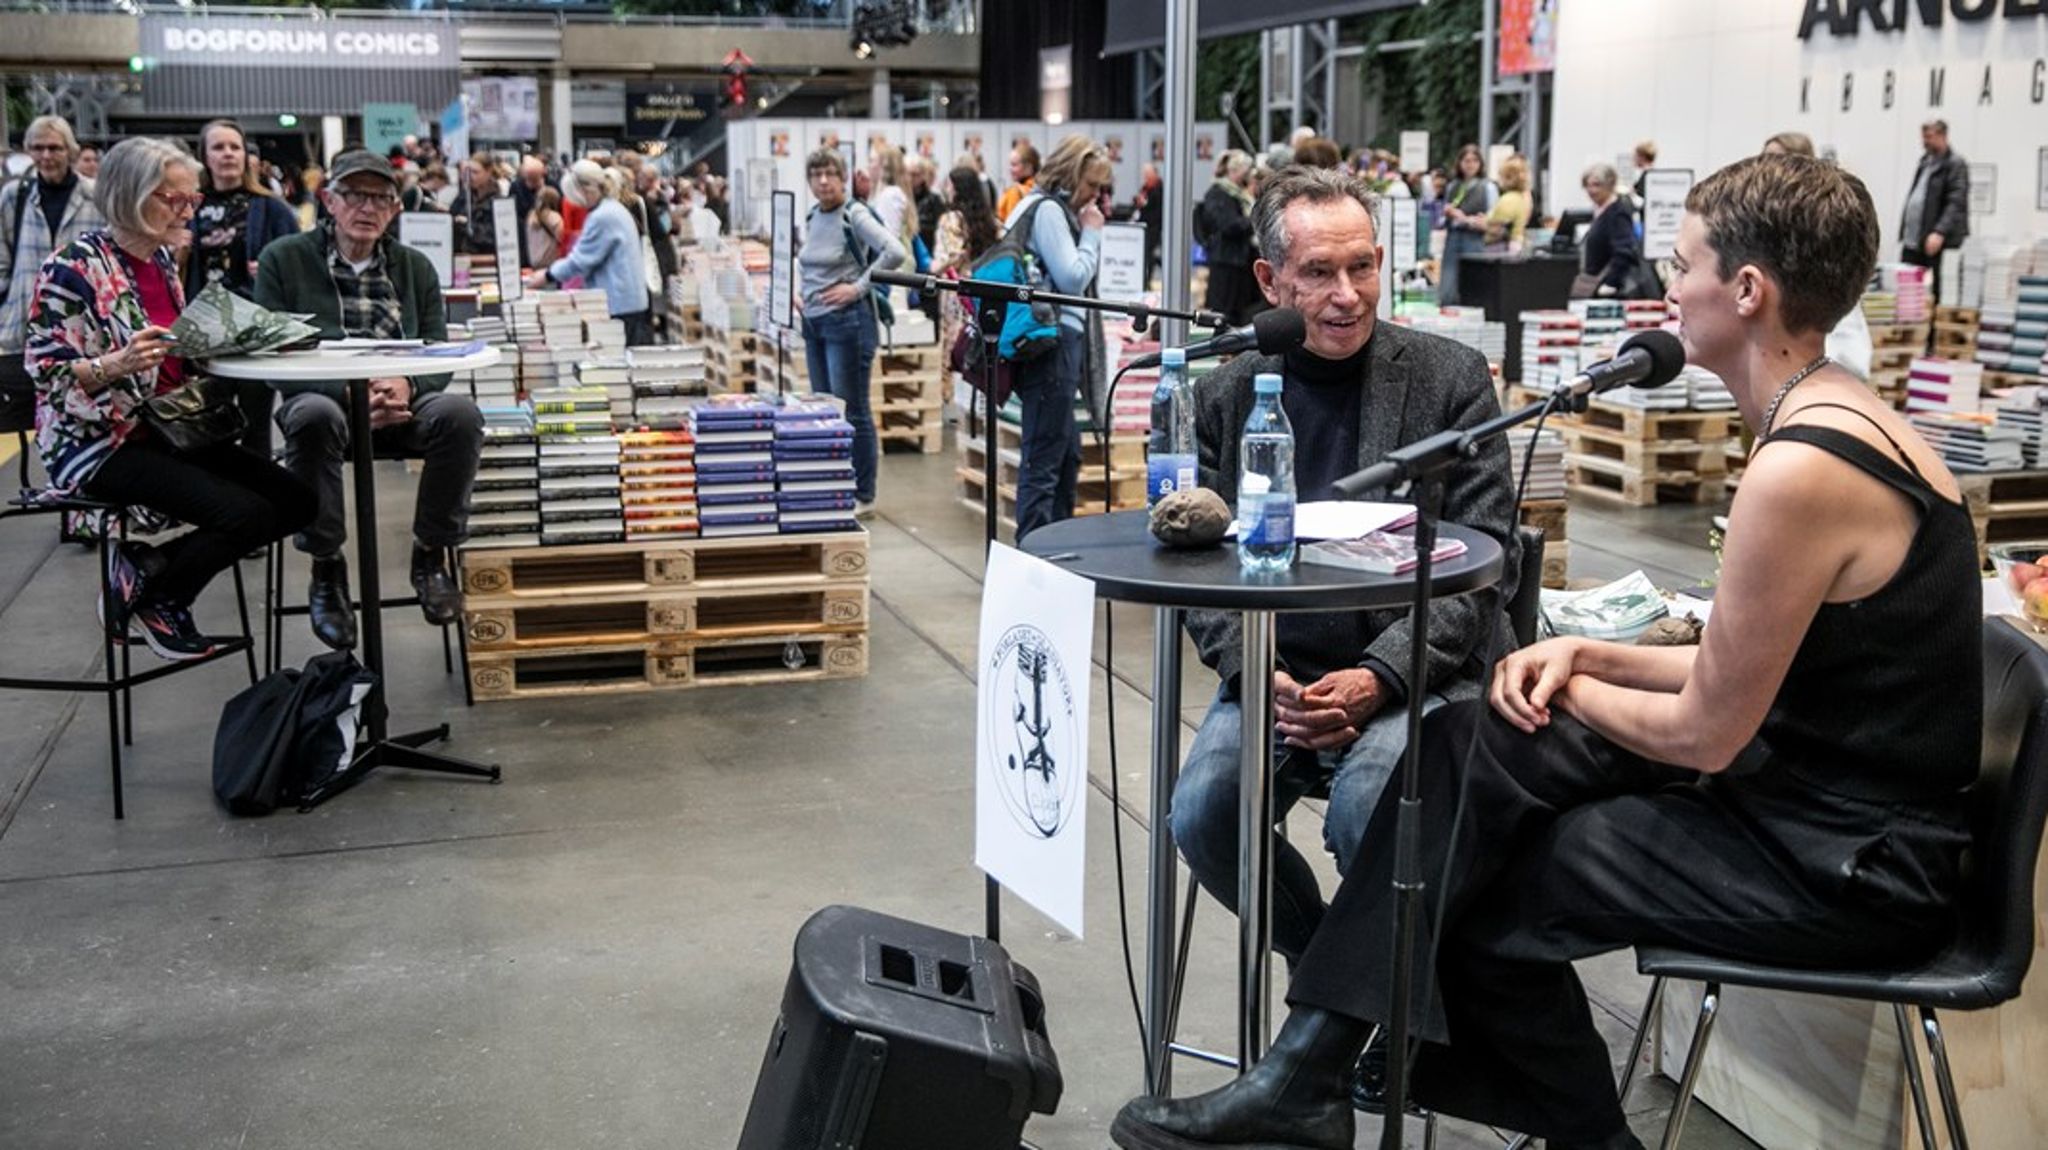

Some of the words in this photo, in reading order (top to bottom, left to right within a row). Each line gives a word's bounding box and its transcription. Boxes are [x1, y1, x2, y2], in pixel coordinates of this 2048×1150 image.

[164, 28, 327, 53] BOGFORUM
[334, 32, 440, 55] COMICS
[475, 623, 498, 637] EPAL
